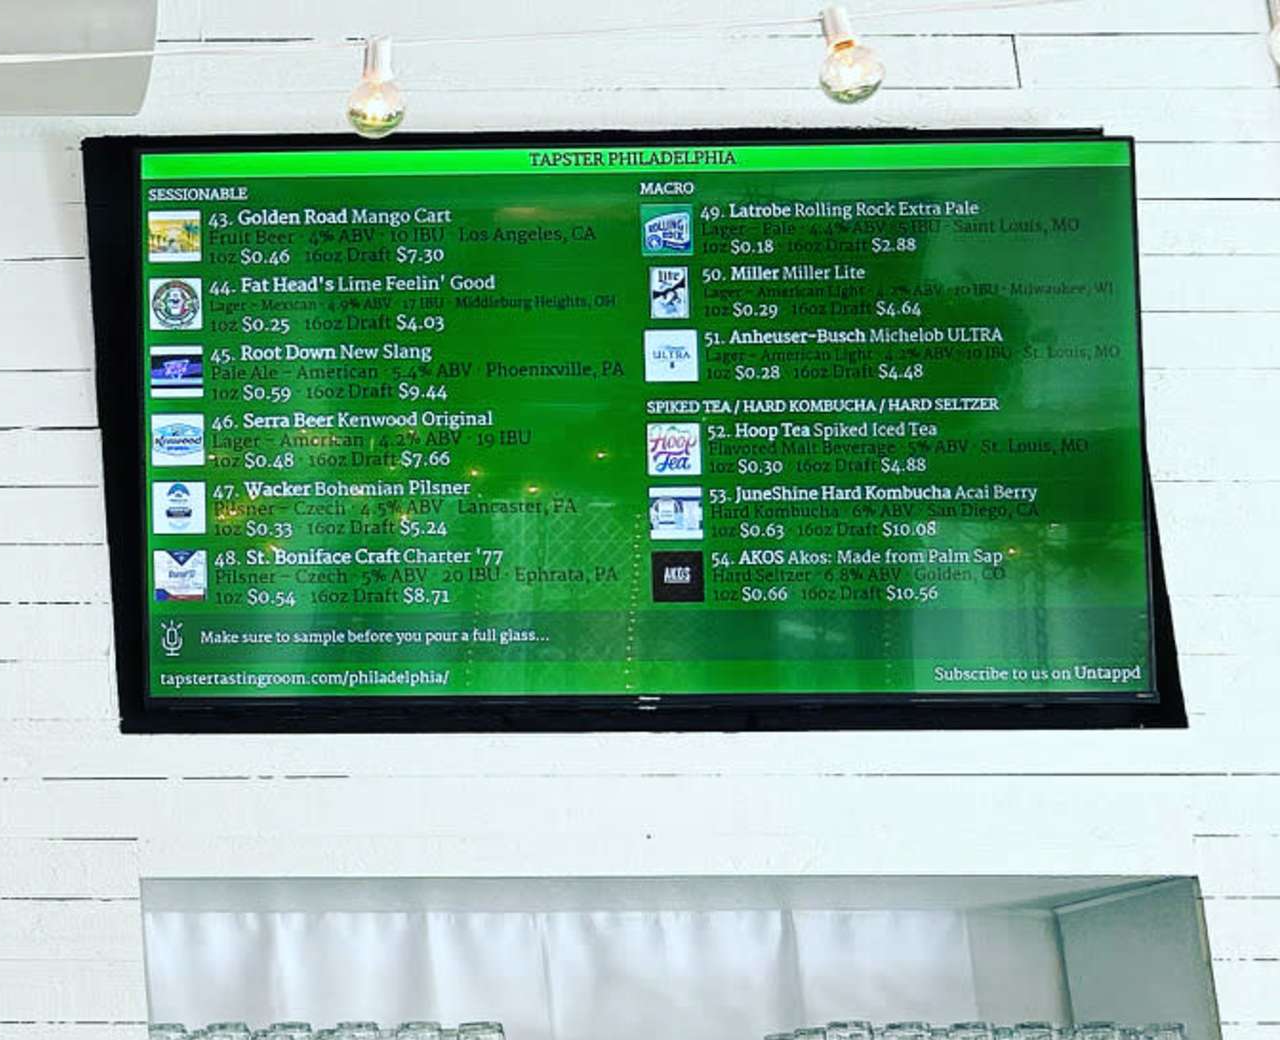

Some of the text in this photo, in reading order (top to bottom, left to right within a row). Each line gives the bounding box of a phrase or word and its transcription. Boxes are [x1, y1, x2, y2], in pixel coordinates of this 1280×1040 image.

[529, 150, 736, 167] TAPSTER PHILADELPHIA
[148, 187, 248, 201] SESSIONABLE
[639, 181, 695, 195] MACRO
[208, 207, 452, 229] 43. Golden Road Mango Cart
[396, 245, 445, 264] $7.30
[871, 237, 917, 254] $2.88
[209, 274, 496, 296] 44. Fat Head's Lime Feelin' Good
[396, 313, 445, 332] $4.03
[704, 327, 1004, 348] 51. Anheuser-Busch Michelob ULTRA
[646, 399, 701, 414] SPIKED
[701, 399, 733, 414] TEA
[742, 399, 787, 413] HARD
[789, 398, 877, 413] KOMBUCHA
[888, 398, 933, 412] HARD
[934, 397, 1000, 411] SELTZER
[709, 484, 1038, 504] 53. JuneShine Hard Kombucha Acai Berry
[882, 520, 937, 538] $10.08
[160, 670, 450, 689] tapstertastingroom.com/philadelphia/
